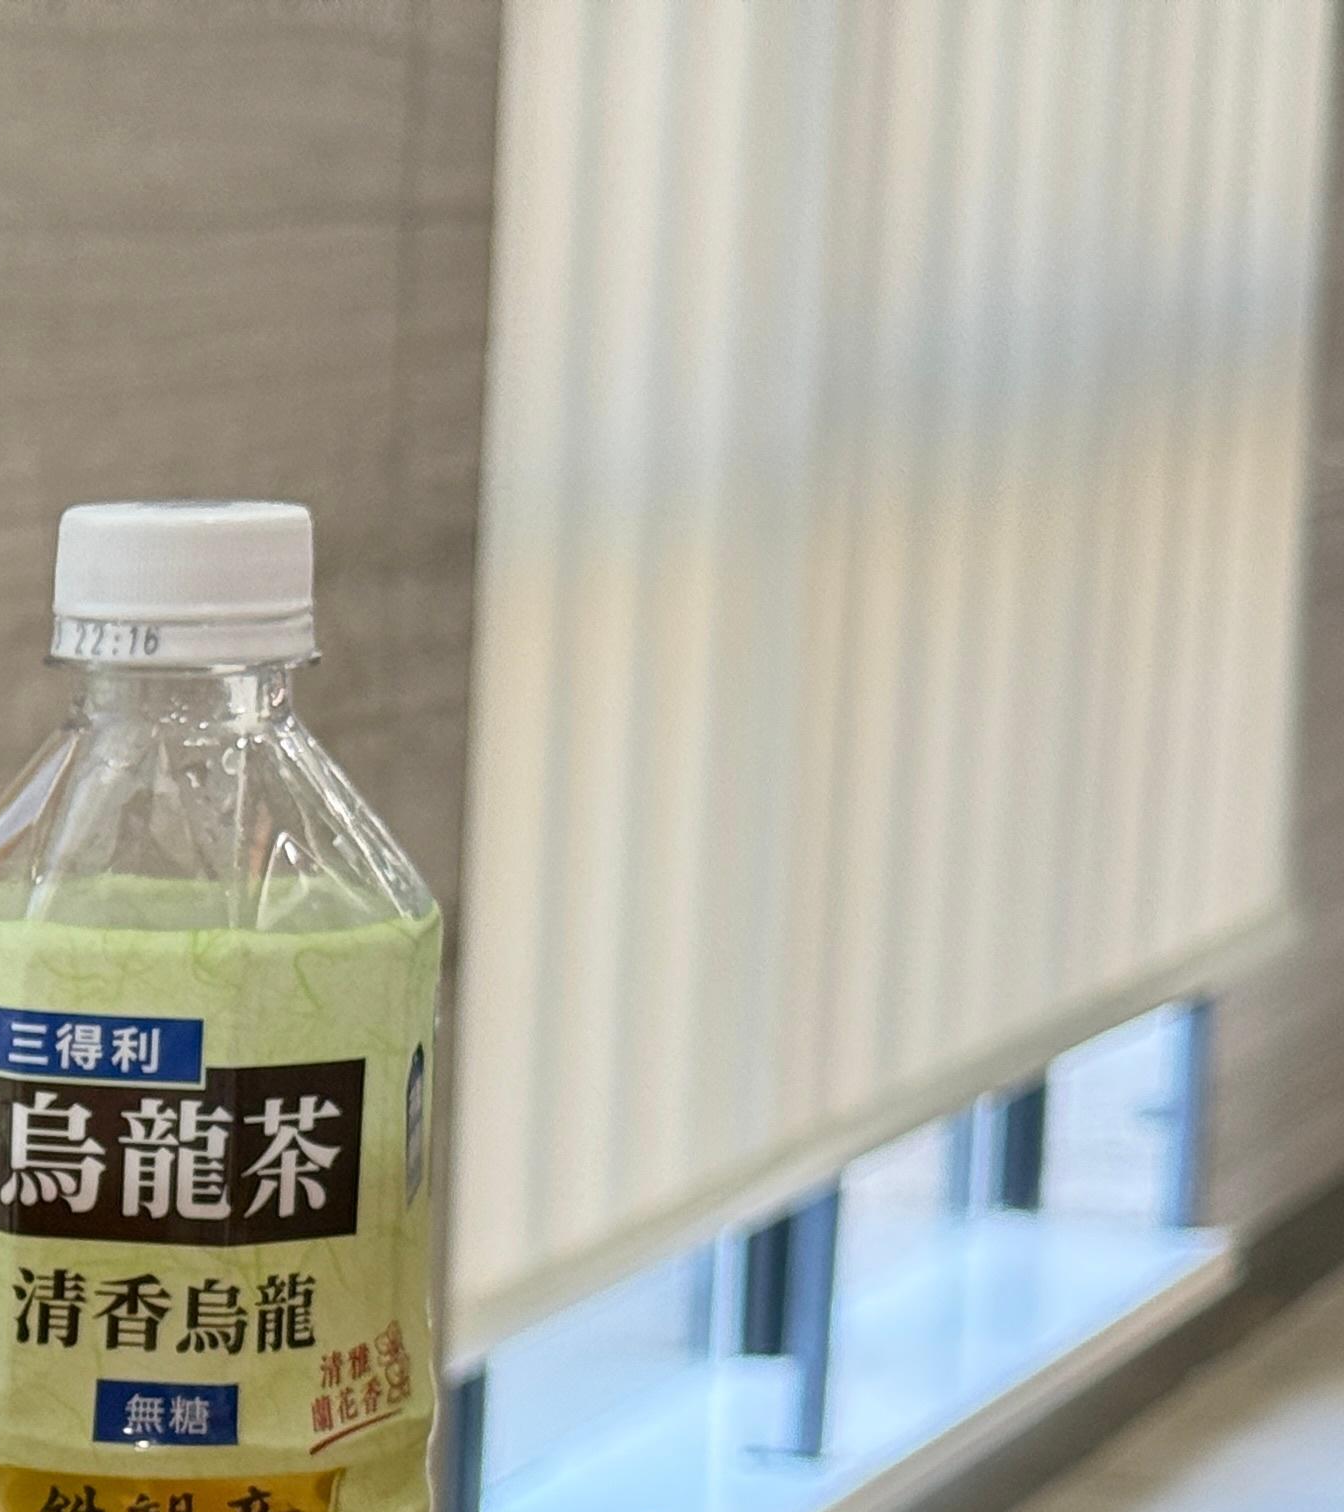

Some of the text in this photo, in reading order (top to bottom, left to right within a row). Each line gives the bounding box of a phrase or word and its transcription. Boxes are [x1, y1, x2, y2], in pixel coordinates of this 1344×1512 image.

[74, 622, 160, 656] 22:16
[7, 1019, 162, 1075] 三得利
[0, 1090, 343, 1222] 烏龍茶
[12, 1265, 318, 1357] 清香烏龍
[124, 1392, 211, 1436] 無糖
